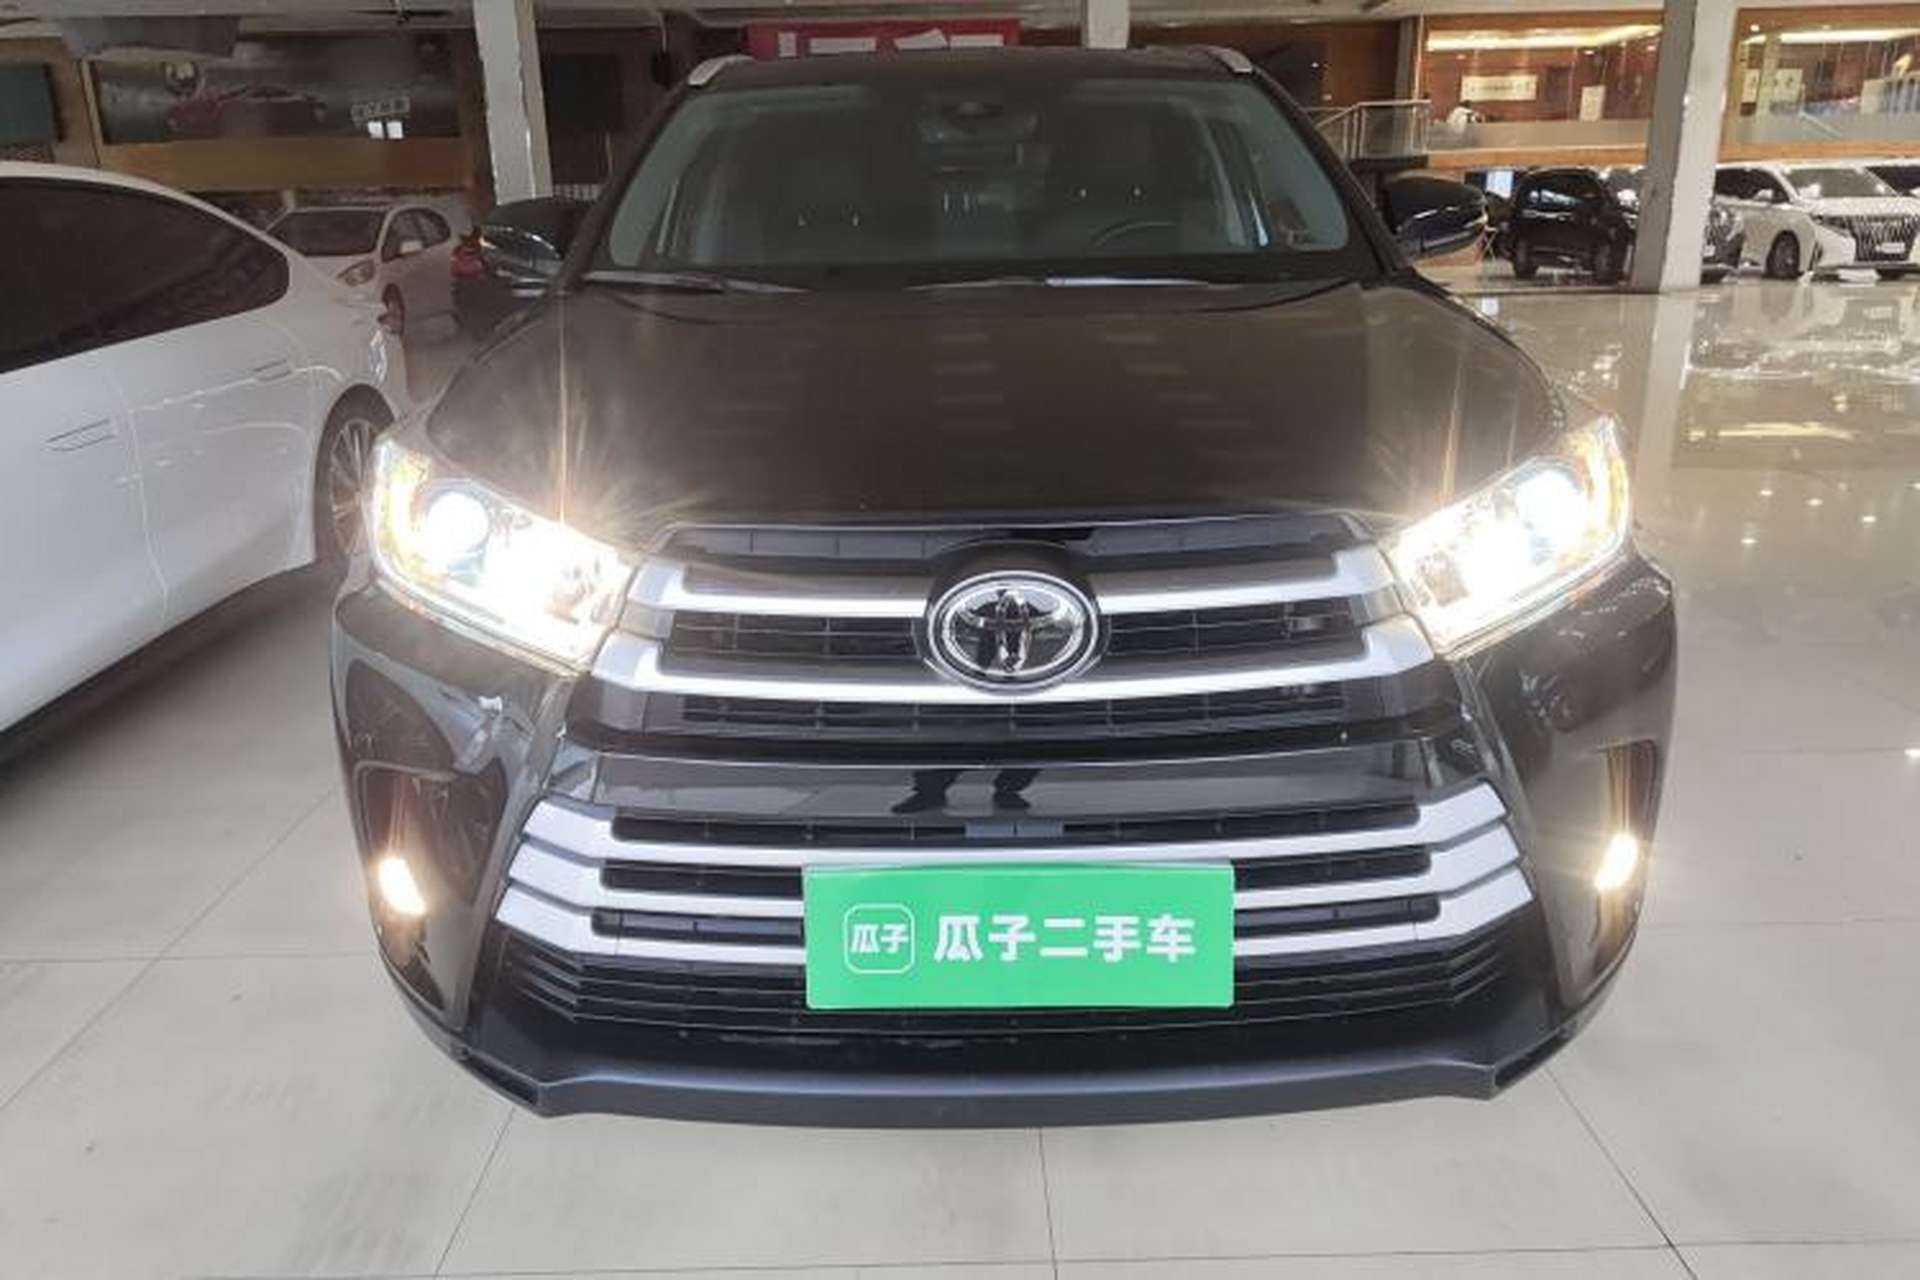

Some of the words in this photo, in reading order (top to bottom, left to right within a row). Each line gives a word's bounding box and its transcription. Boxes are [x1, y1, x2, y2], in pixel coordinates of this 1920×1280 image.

[850, 922, 910, 955] 瓜子
[934, 914, 1197, 964] 瓜子二手车
